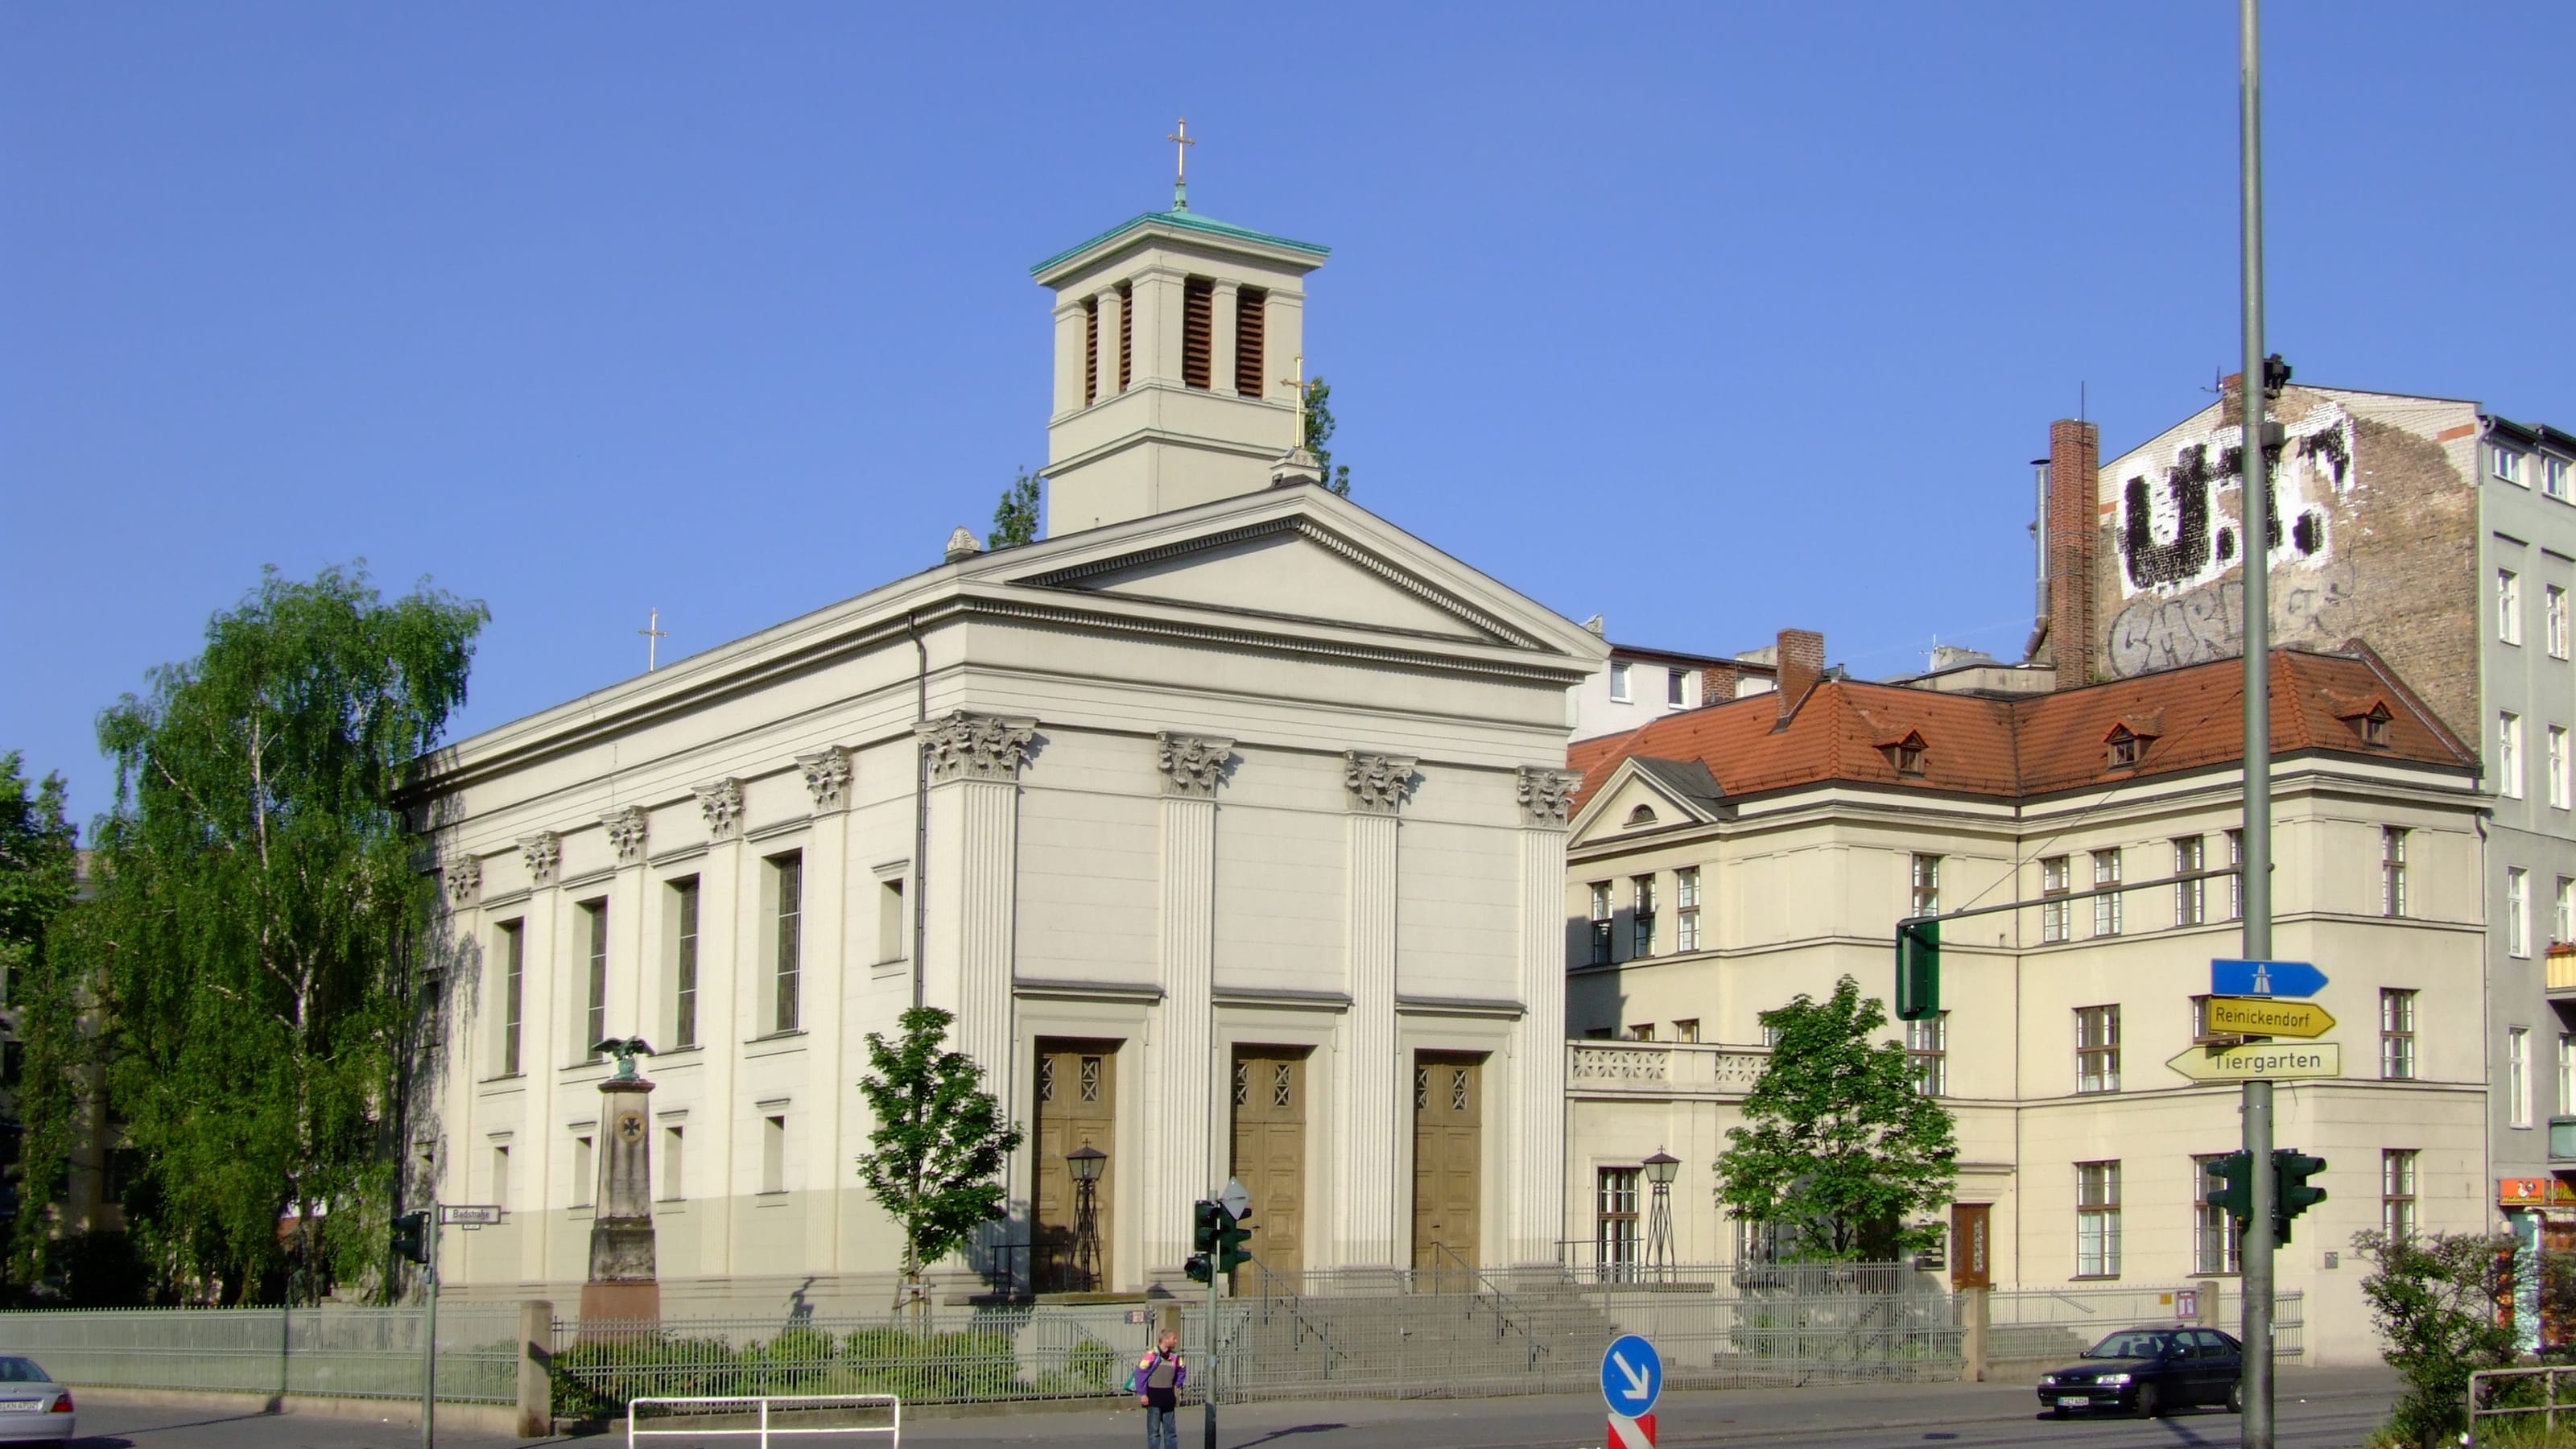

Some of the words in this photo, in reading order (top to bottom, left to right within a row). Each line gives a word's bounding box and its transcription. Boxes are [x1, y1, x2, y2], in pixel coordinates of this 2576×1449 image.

[2215, 1006, 2310, 1028] Reinickendorf
[2213, 1052, 2321, 1073] Tiergarten
[452, 1209, 490, 1220] Badstraße
